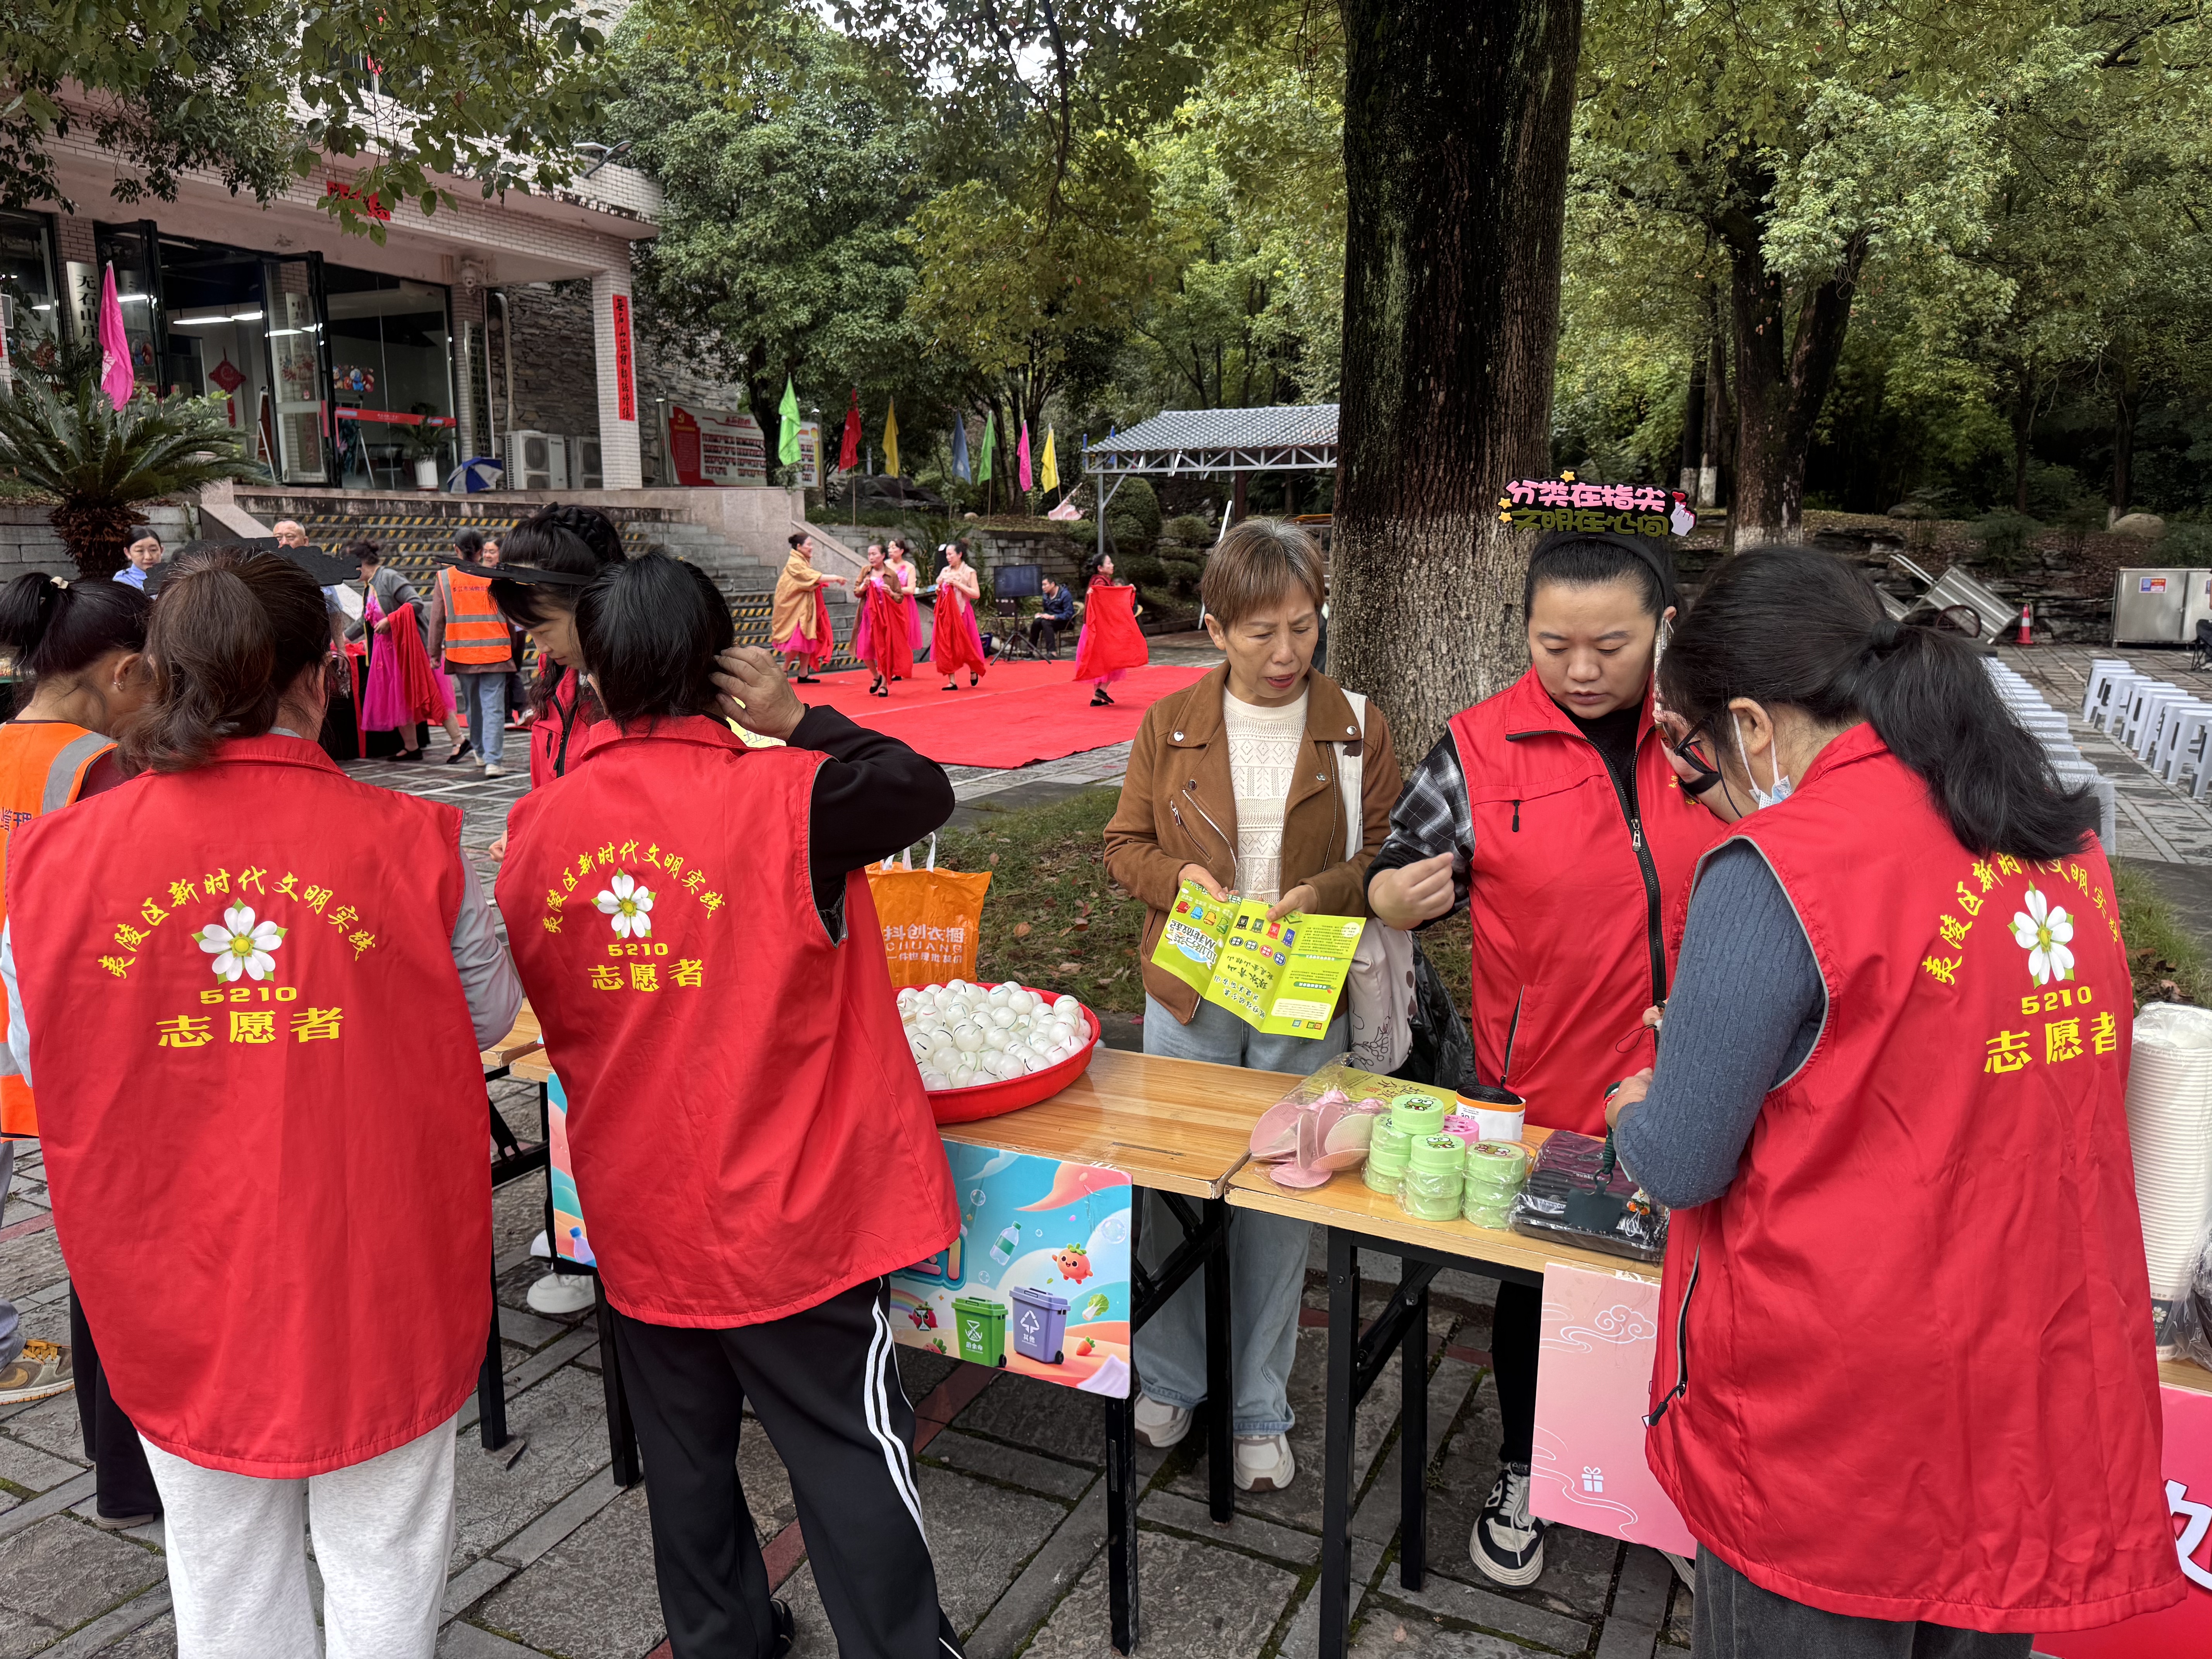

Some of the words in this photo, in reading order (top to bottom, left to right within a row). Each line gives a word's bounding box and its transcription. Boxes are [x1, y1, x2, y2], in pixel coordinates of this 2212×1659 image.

[1506, 480, 1666, 512] 分类在指尖
[1511, 507, 1669, 537] 文明在心间
[543, 839, 725, 933] 夷陵区新时代文明实践
[97, 866, 376, 979] 夷陵区新时代文明实践
[883, 924, 965, 943] 抖创衣橱
[608, 943, 668, 957] 5210
[587, 958, 704, 992] 志愿者
[201, 986, 297, 1005] 5210
[2021, 986, 2092, 1015] 5210
[156, 1007, 344, 1048] 志愿者
[1984, 1011, 2117, 1073] 志愿者
